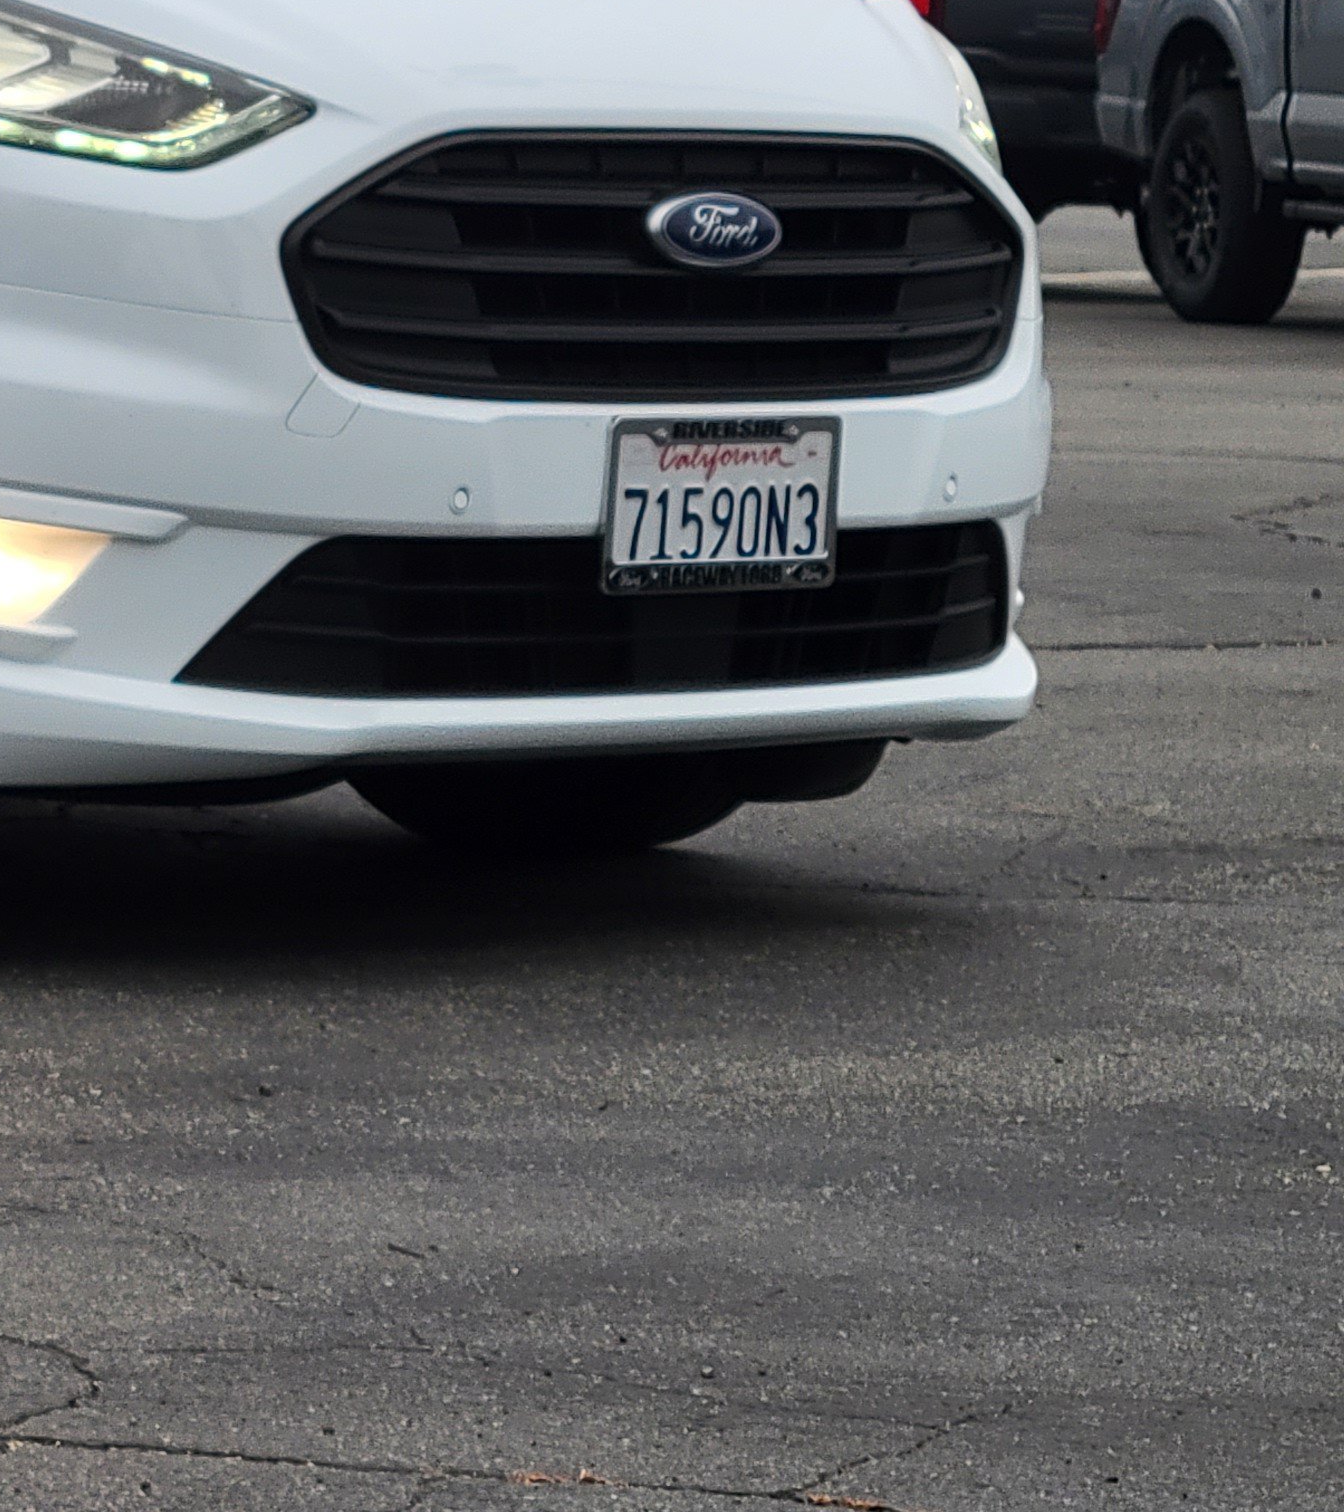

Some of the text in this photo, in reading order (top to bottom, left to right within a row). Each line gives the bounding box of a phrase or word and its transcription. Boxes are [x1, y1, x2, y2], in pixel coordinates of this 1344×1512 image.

[689, 204, 759, 247] Ford
[673, 419, 786, 439] RIVERSIDE
[658, 443, 796, 482] California
[624, 483, 820, 561] 71590N3
